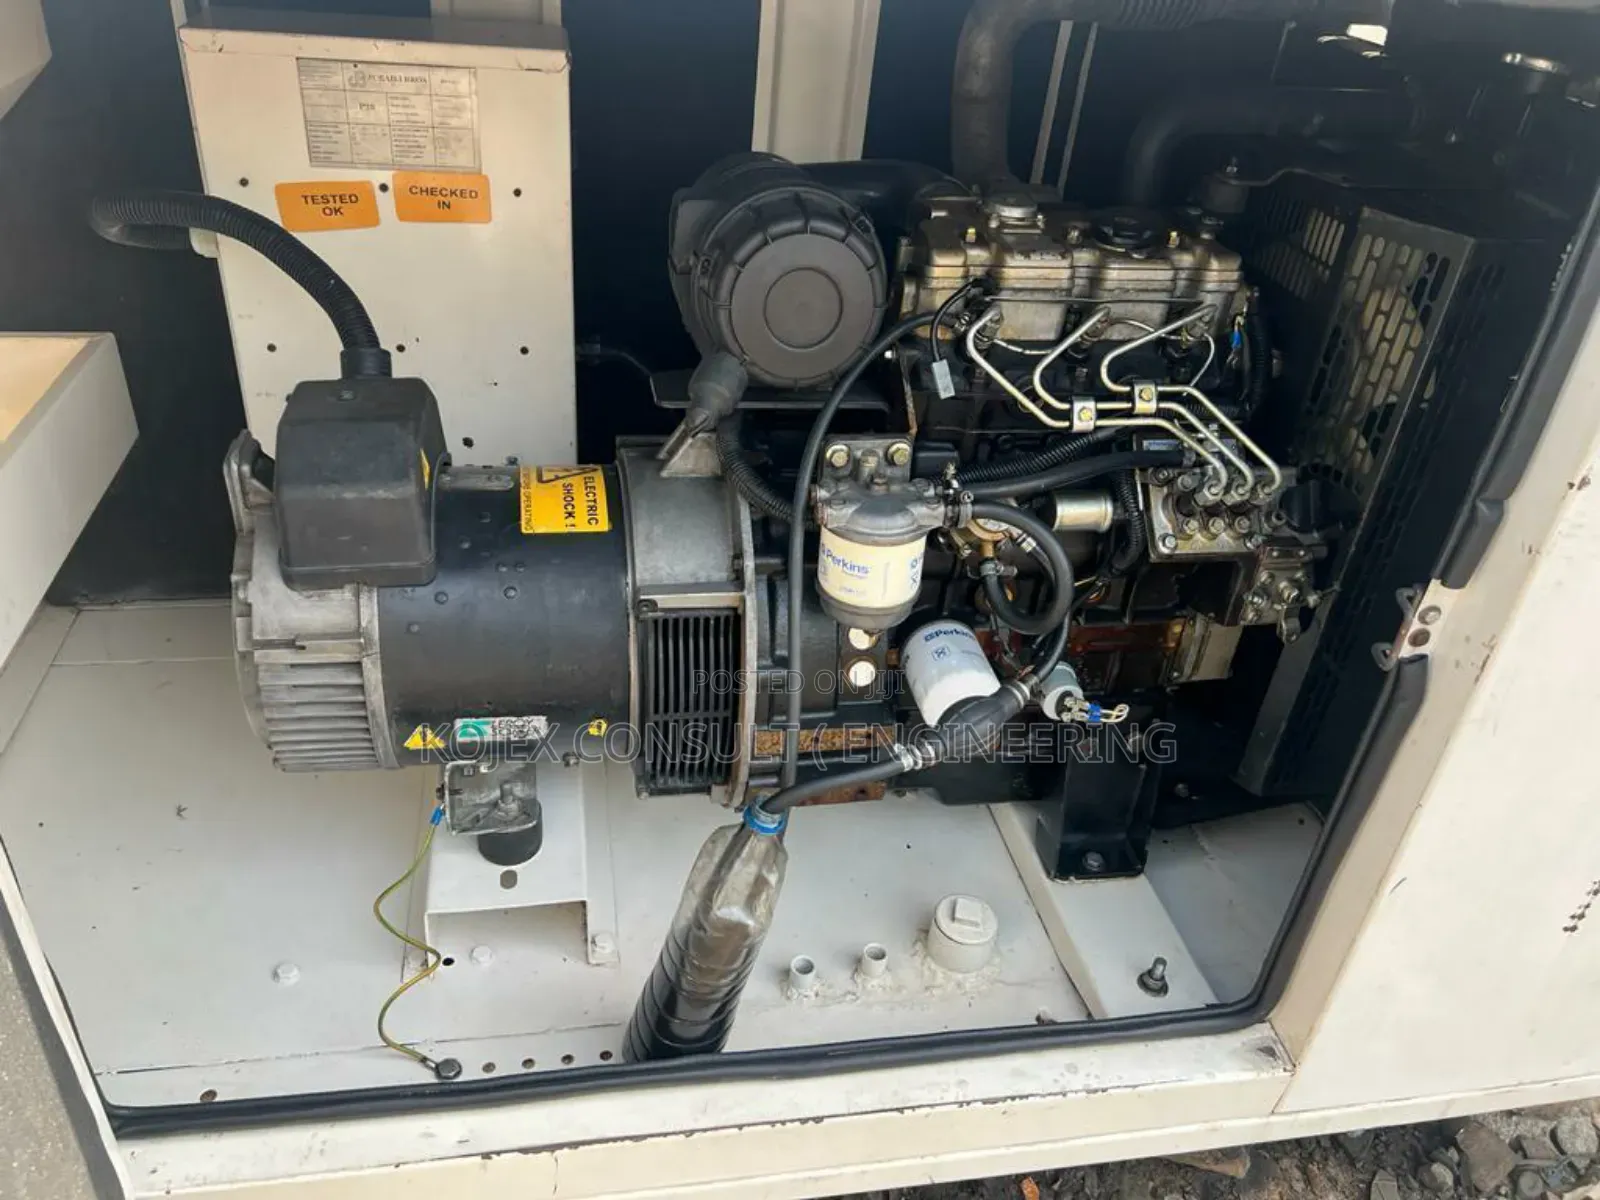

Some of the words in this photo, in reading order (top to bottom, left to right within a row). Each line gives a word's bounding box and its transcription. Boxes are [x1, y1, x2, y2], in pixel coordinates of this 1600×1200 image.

[301, 193, 359, 206] TESTED
[408, 185, 479, 200] CHECKED
[322, 206, 344, 217] OK
[437, 200, 451, 210] IN
[562, 482, 576, 520] SHOCK
[584, 476, 599, 526] ELECTRIC
[826, 548, 870, 575] Perkins
